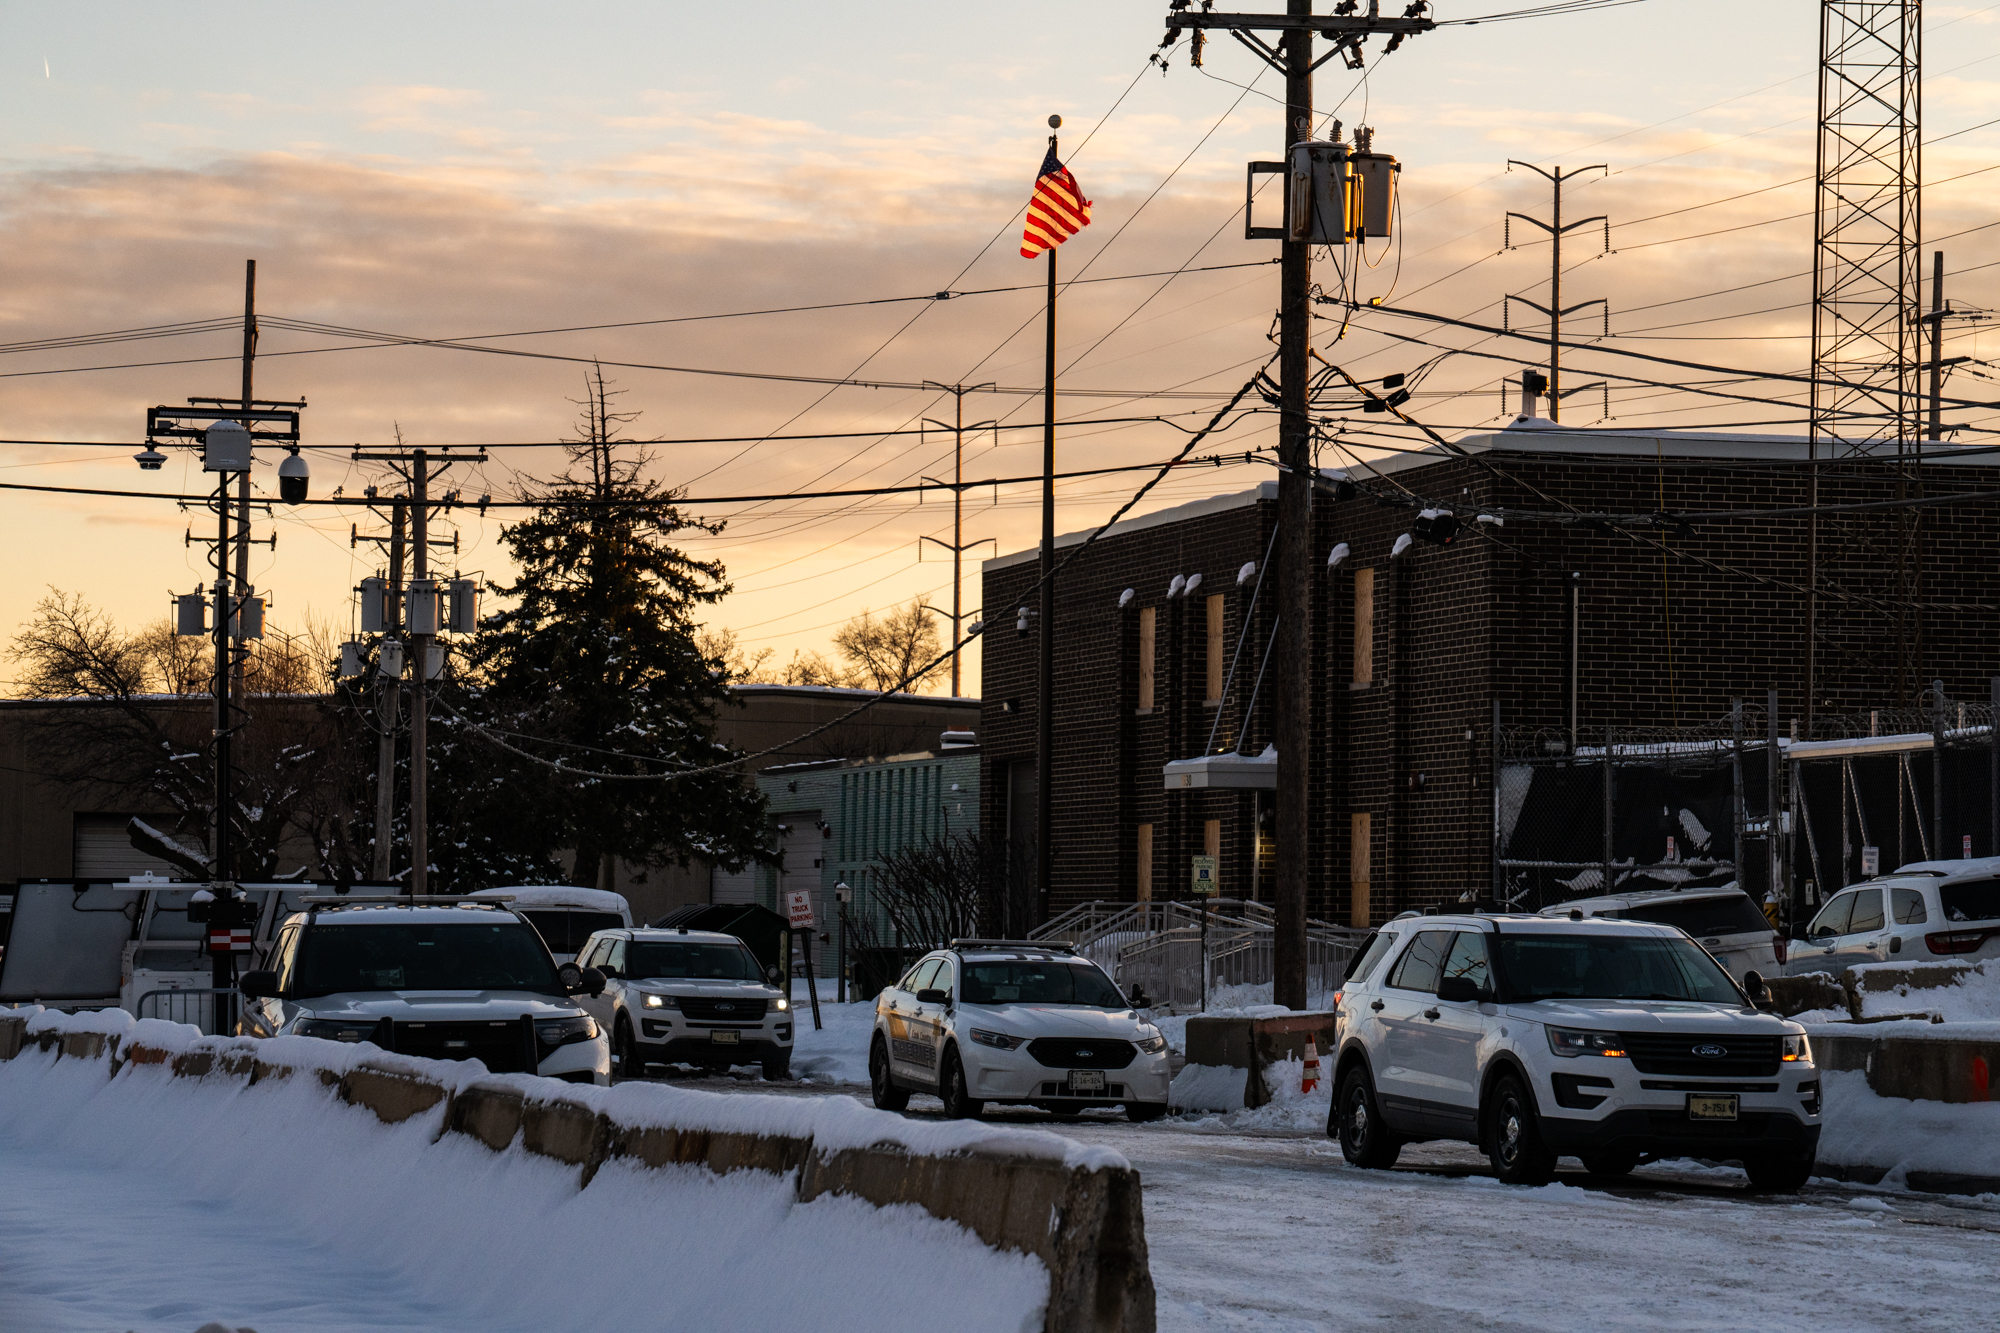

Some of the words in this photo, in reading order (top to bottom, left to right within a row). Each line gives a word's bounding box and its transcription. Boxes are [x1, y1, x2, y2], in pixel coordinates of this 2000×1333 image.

[794, 896, 803, 904] NO
[791, 904, 809, 913] TRUCK
[791, 912, 813, 923] PARKING
[892, 1038, 937, 1070] SHERIFF
[1702, 1103, 1726, 1113] 3-751
